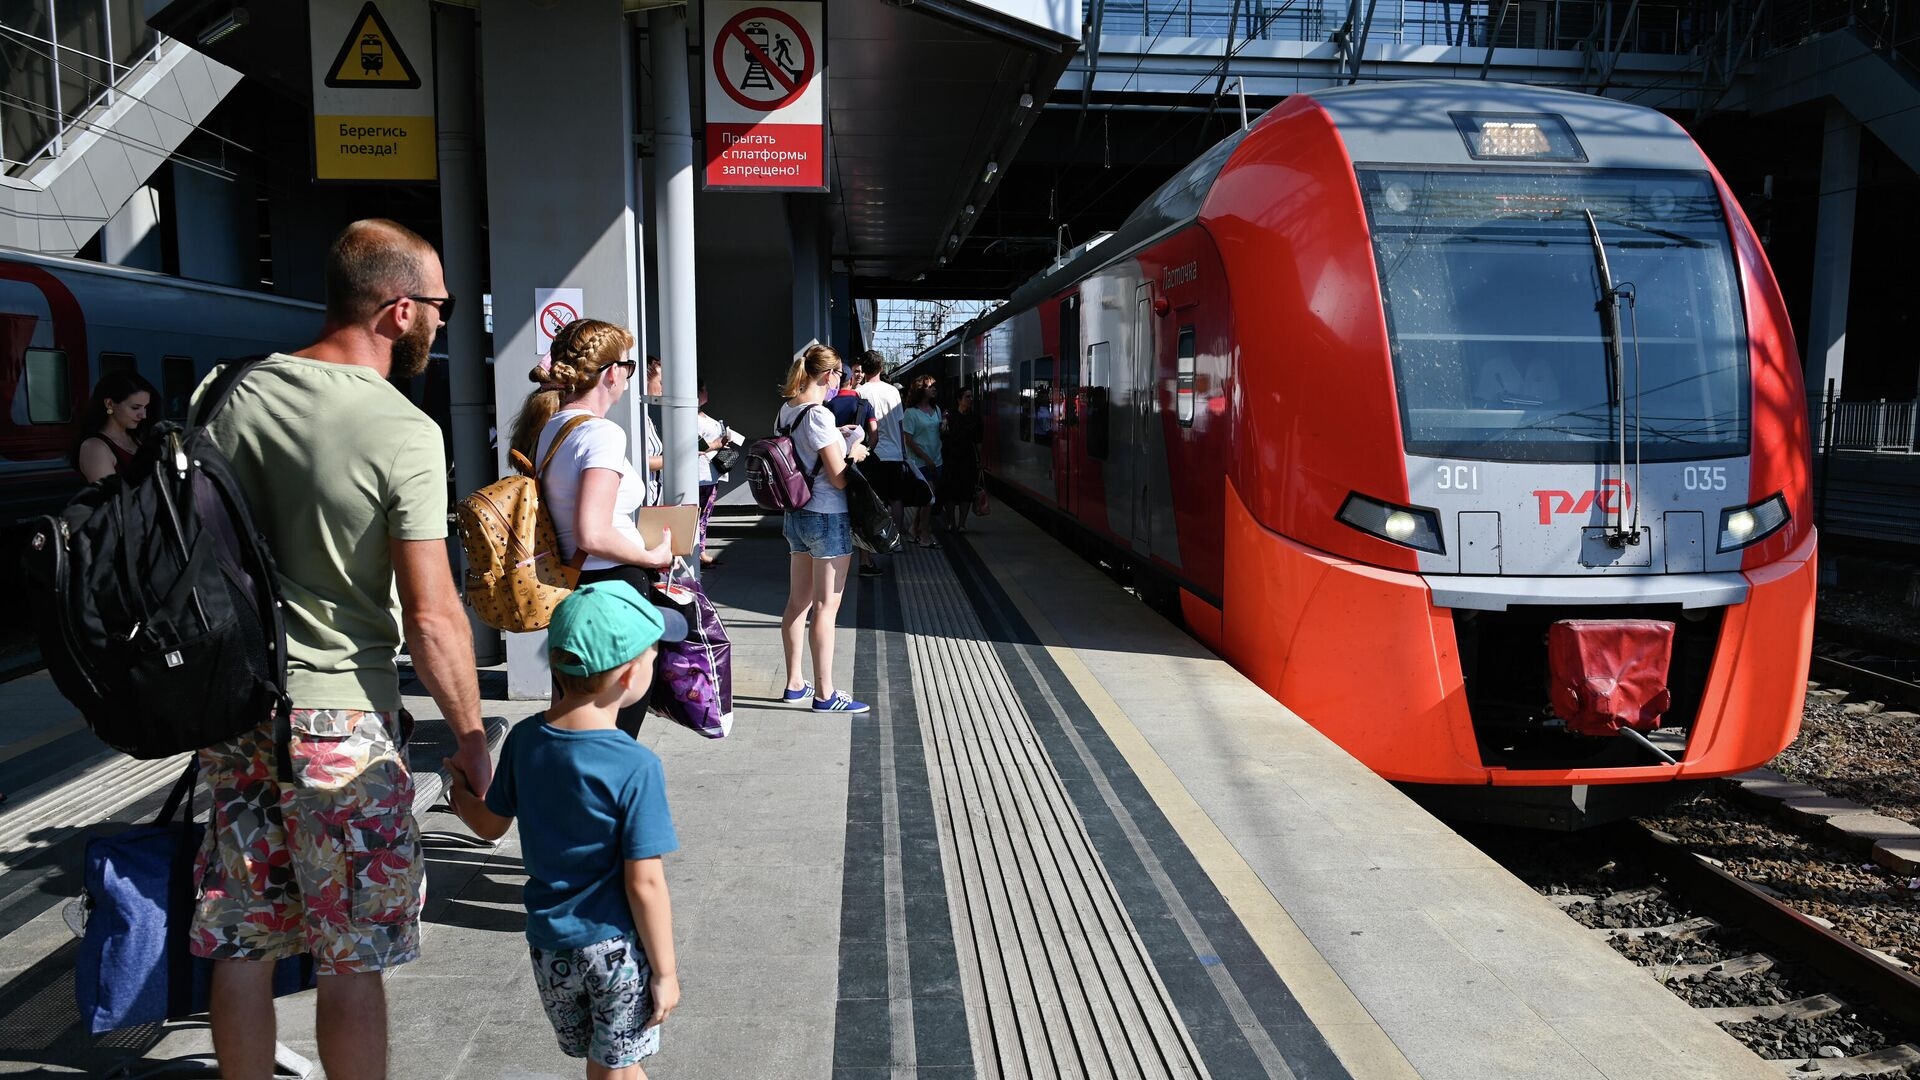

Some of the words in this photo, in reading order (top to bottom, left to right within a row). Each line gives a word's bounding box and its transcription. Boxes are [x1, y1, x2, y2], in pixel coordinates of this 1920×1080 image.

[340, 123, 407, 140] Берегись
[722, 132, 776, 146] Прыгать
[340, 142, 397, 156] поезда!
[722, 150, 728, 159] с
[731, 149, 807, 162] платформы
[722, 164, 800, 177] запрещено!
[1163, 261, 1197, 290] Ласточка
[1684, 466, 1727, 490] 035
